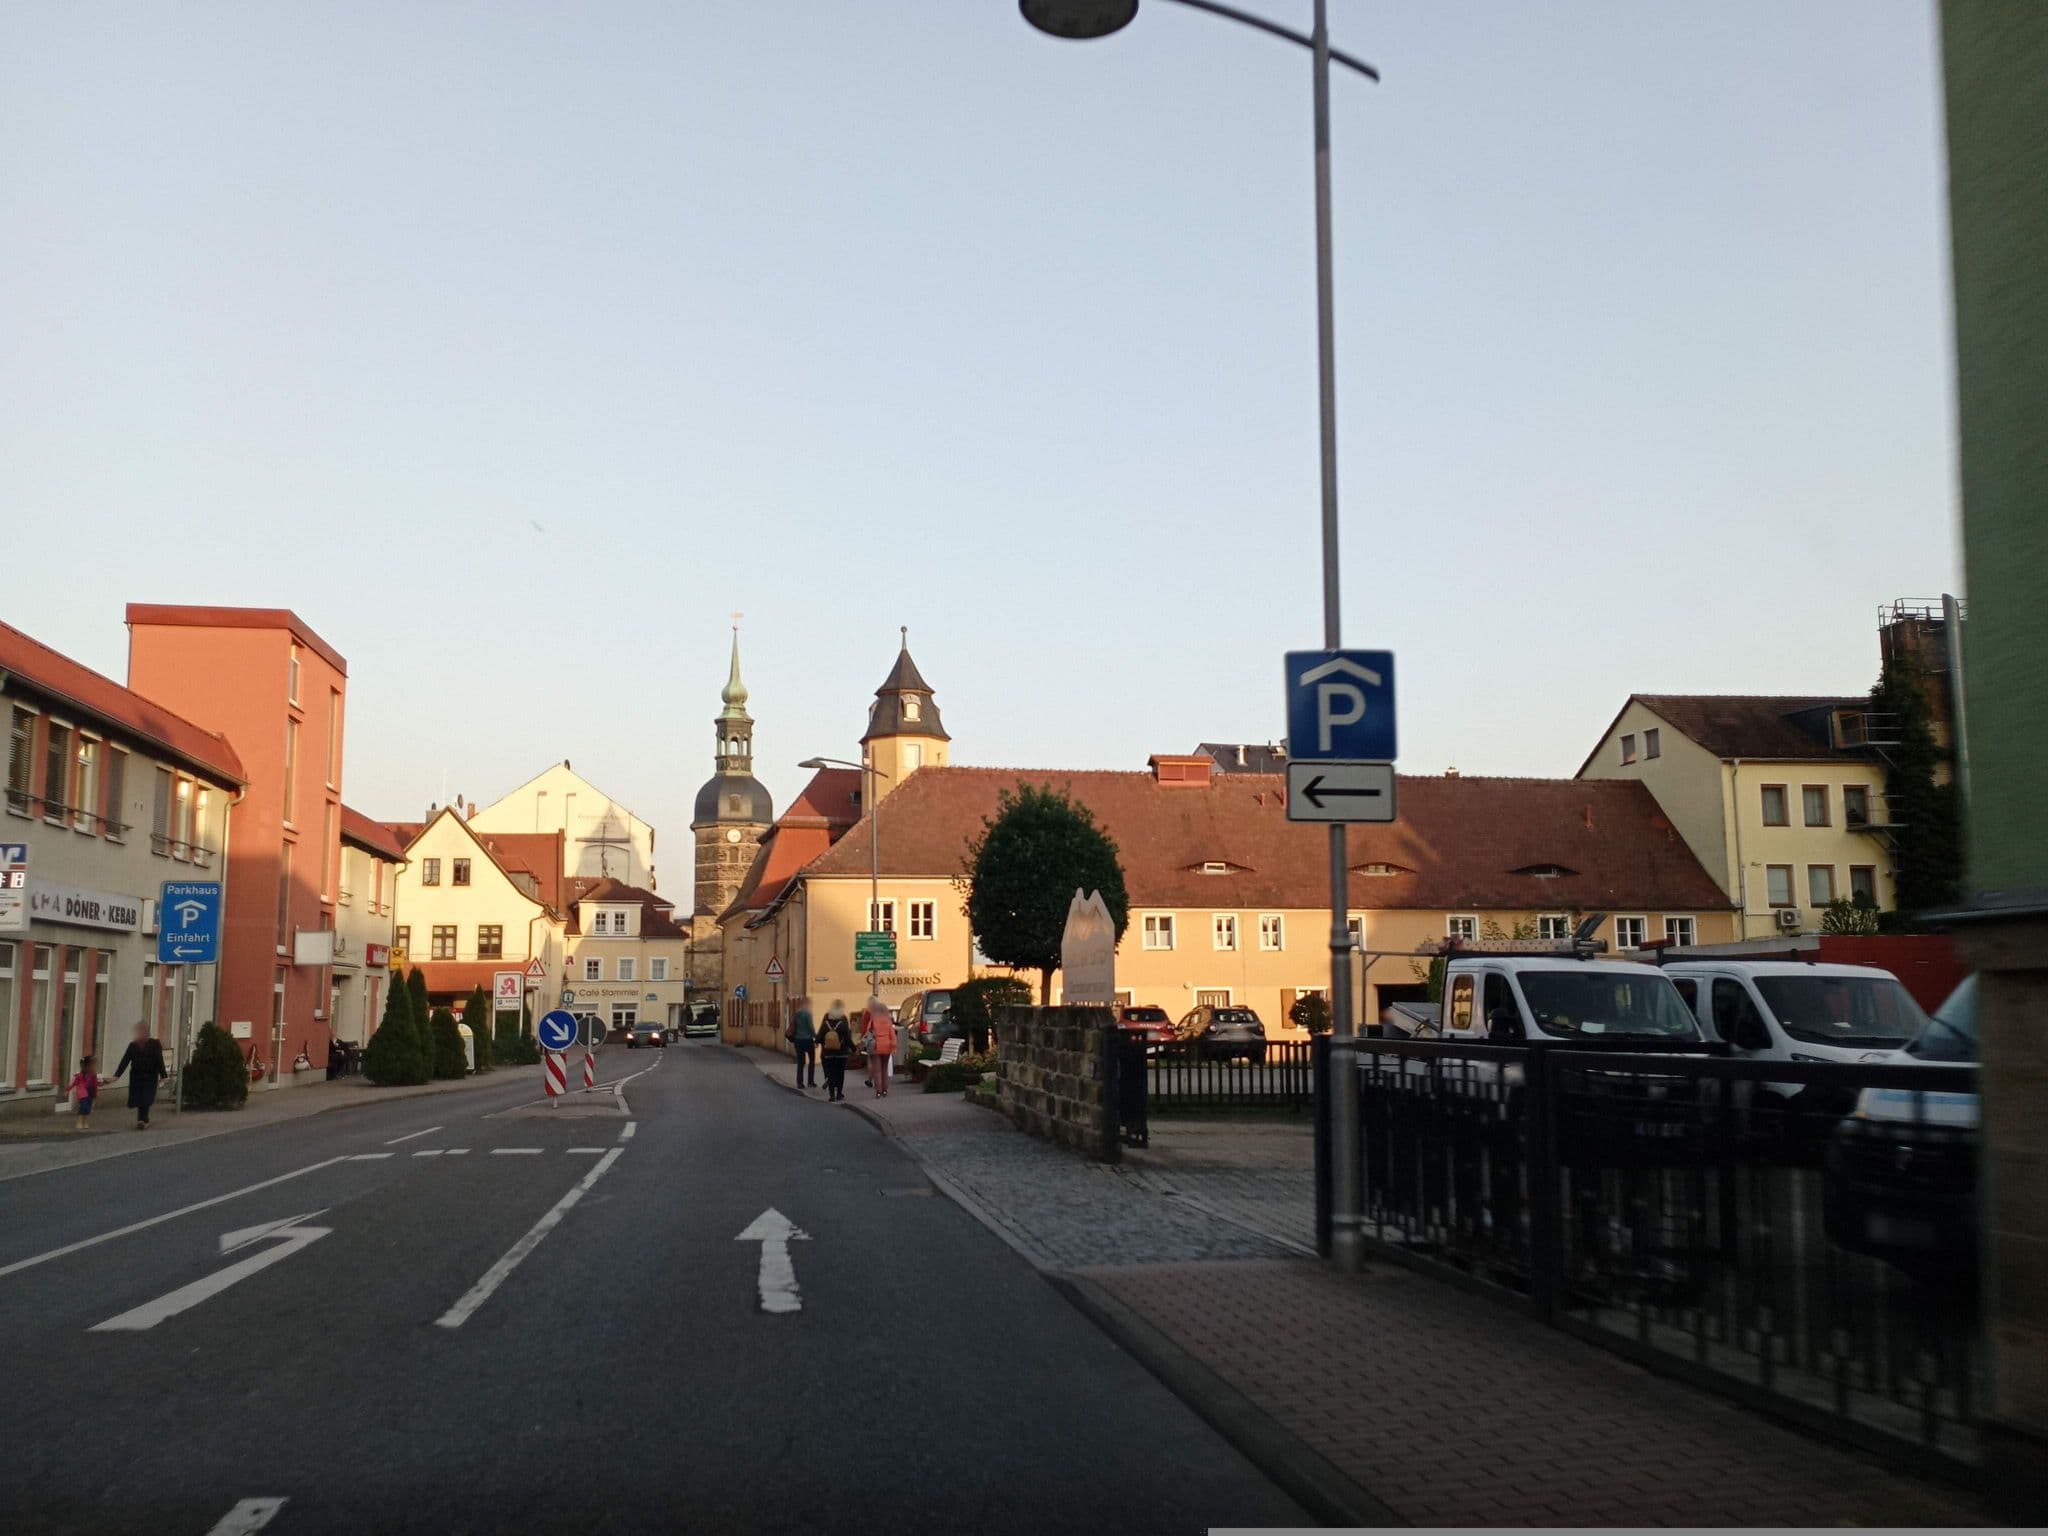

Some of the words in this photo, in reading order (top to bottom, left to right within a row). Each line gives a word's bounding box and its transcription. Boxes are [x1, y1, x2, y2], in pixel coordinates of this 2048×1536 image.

[1318, 683, 1366, 752] P
[0, 872, 24, 888] :18
[167, 885, 218, 895] Parkhaus
[67, 894, 100, 921] DÖNER
[109, 905, 137, 926] KEBAB
[182, 908, 199, 928] P
[167, 932, 210, 942] Einfahrt
